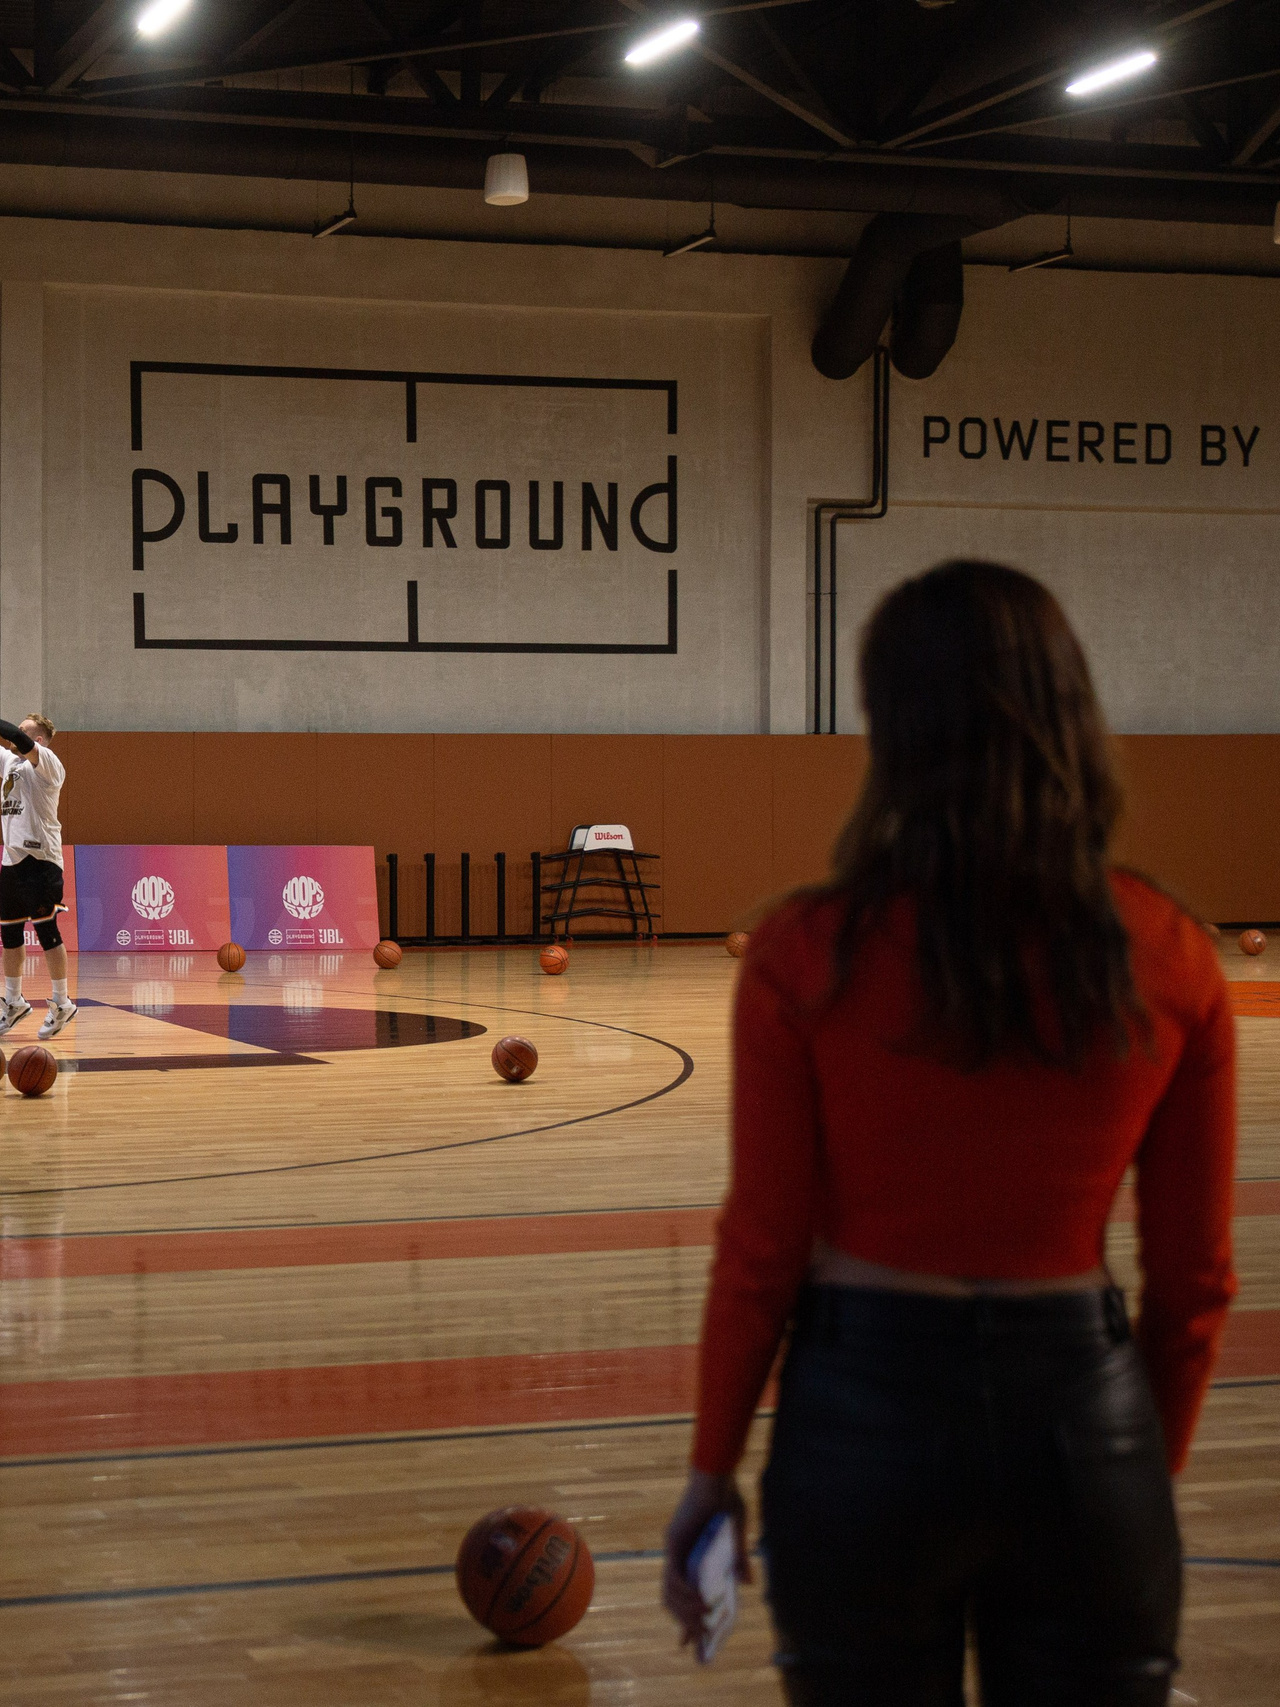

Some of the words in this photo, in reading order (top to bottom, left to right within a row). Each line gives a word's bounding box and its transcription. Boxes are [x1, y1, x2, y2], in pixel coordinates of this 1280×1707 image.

[923, 415, 1173, 465] POWERED
[1200, 424, 1261, 467] BY
[594, 832, 624, 841] Wilson
[131, 875, 175, 907] HOOPS
[282, 875, 325, 907] HOOPS
[168, 930, 194, 945] JBL
[318, 929, 344, 944] JBL
